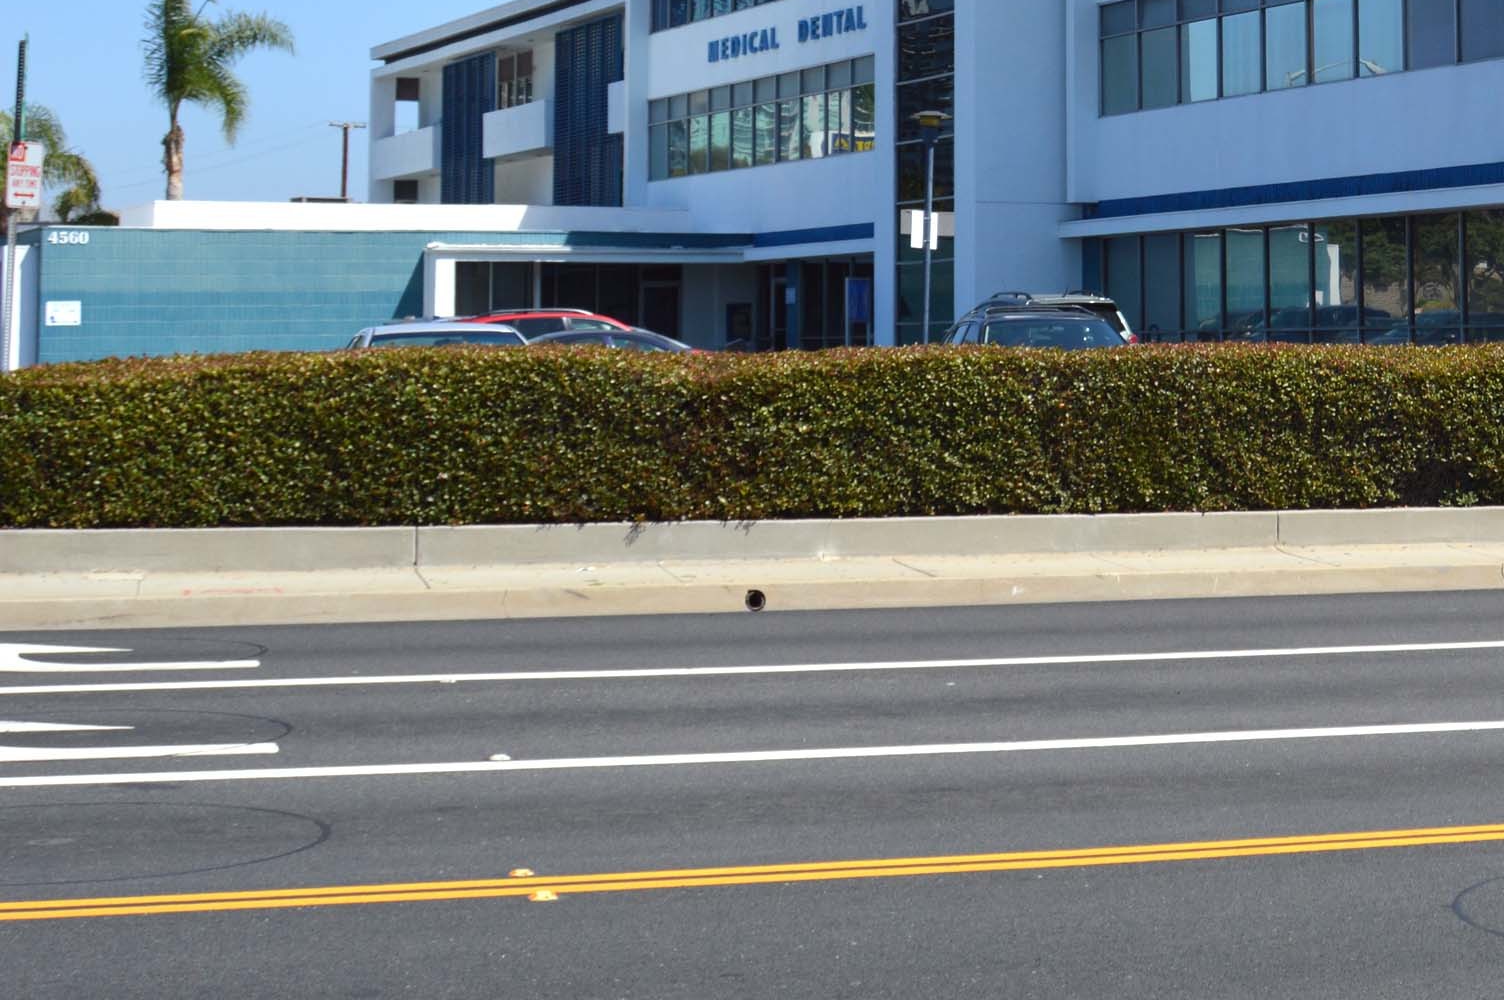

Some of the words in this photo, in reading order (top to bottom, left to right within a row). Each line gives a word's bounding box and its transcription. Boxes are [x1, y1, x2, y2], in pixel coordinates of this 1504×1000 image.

[708, 26, 780, 63] MEDICAL
[797, 5, 867, 43] DENTAL
[47, 231, 90, 245] 4560
